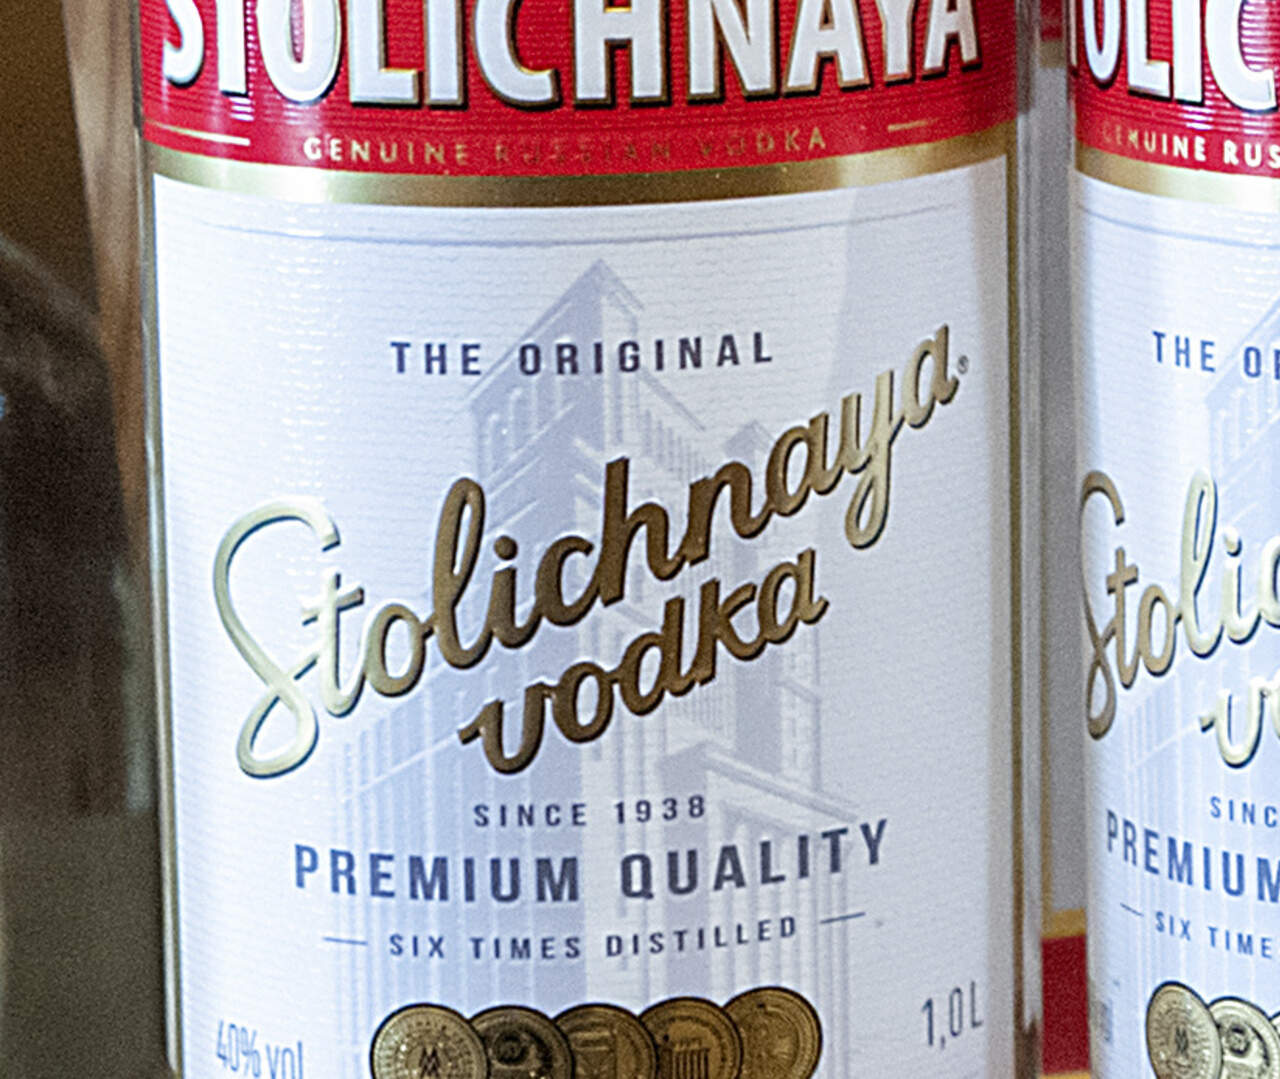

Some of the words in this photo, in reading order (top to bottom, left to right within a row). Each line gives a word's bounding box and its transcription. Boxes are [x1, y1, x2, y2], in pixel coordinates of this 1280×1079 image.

[302, 135, 469, 165] GENUINE
[698, 125, 829, 158] VODKA
[389, 340, 482, 376] THE
[518, 330, 775, 376] ORIGINAL
[1151, 330, 1217, 374] THE
[211, 322, 958, 780] Stolichnaya
[457, 547, 830, 777] vodka
[472, 804, 588, 829] SINCE
[614, 794, 707, 825] 1938
[293, 842, 581, 904] PREMIUM
[620, 817, 889, 901] QUALITY
[388, 932, 446, 960] SIX
[471, 936, 583, 962] TIMES
[605, 915, 798, 958] DISTILLED
[1154, 909, 1194, 944] SIX
